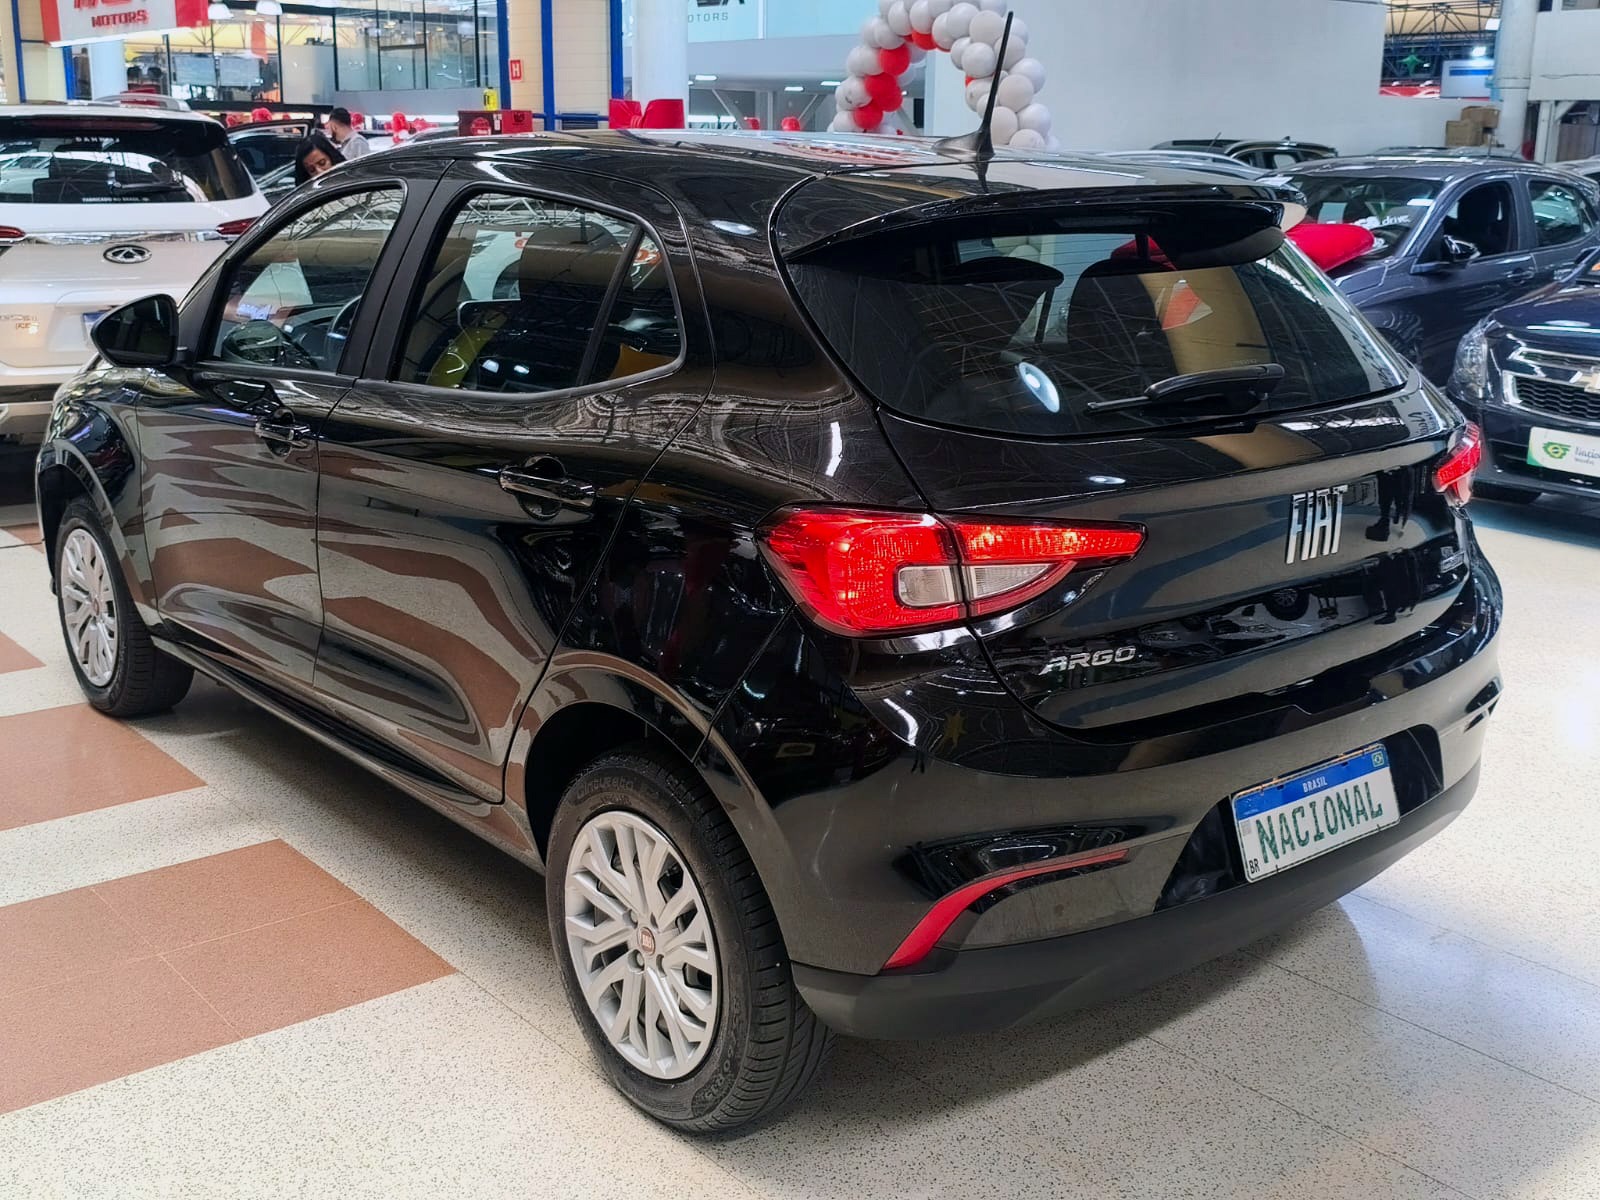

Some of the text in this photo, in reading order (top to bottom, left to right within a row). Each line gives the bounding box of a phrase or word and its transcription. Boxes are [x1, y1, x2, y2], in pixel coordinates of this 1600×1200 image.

[91, 10, 148, 27] MOTORS
[688, 12, 729, 23] OTORS
[1285, 484, 1348, 564] FIAT
[1038, 646, 1136, 675] ARGO
[1302, 776, 1328, 793] BRASIL
[1255, 782, 1383, 864] NACIONAL
[1248, 858, 1260, 875] BR
